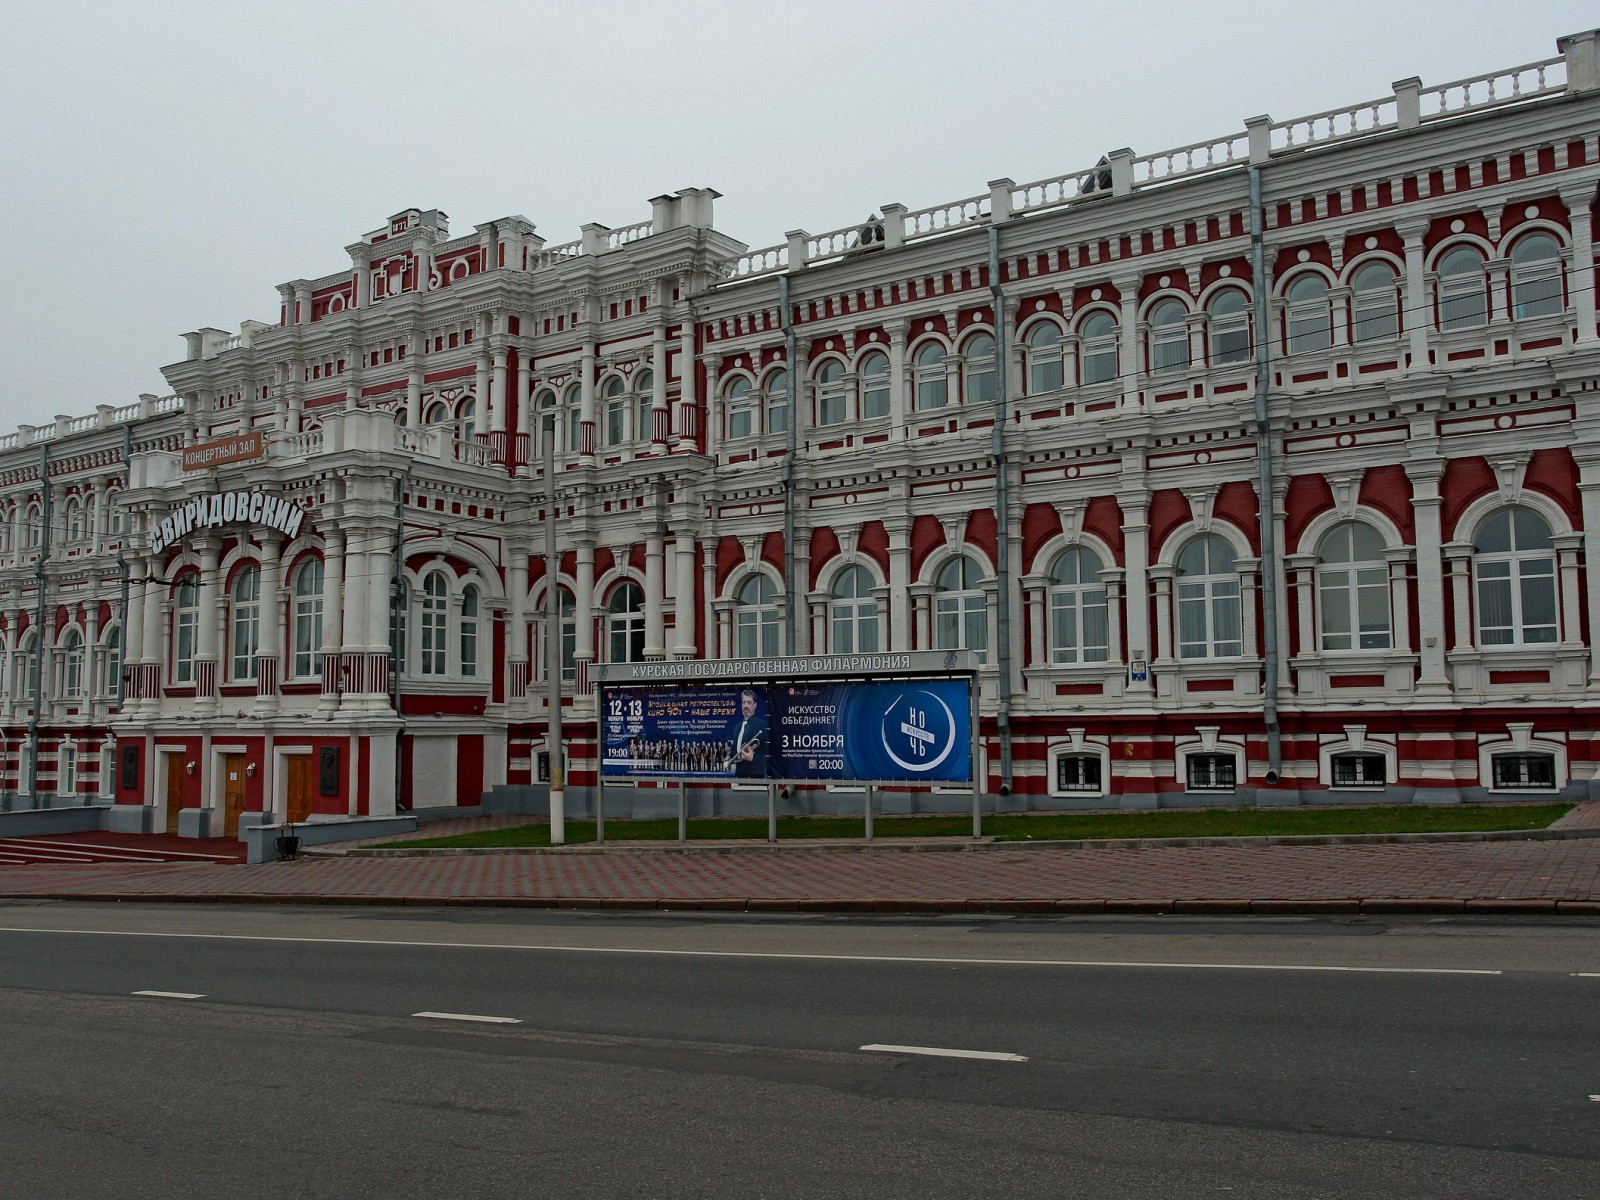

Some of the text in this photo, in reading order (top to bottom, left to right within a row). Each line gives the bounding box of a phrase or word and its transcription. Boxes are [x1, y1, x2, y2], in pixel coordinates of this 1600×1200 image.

[393, 220, 407, 233] 1877
[185, 439, 256, 465] КОНЦЕРТНЫЙ ЗАЛ
[632, 655, 911, 678] КУРСКАЯ ГОСУДАРСТВЕННАЯ ФИЛАРМОНИЯ
[609, 700, 643, 716] 12 13
[712, 708, 736, 716] ВРЕМЯ
[788, 705, 836, 714] ИСКУССТВО
[781, 715, 836, 726] ОБЪЕДИНЯЕТ
[909, 707, 925, 729] НО
[782, 734, 844, 748] 3 НОЯБРЯ
[607, 748, 628, 758] 19:00
[819, 759, 844, 770] 20:00
